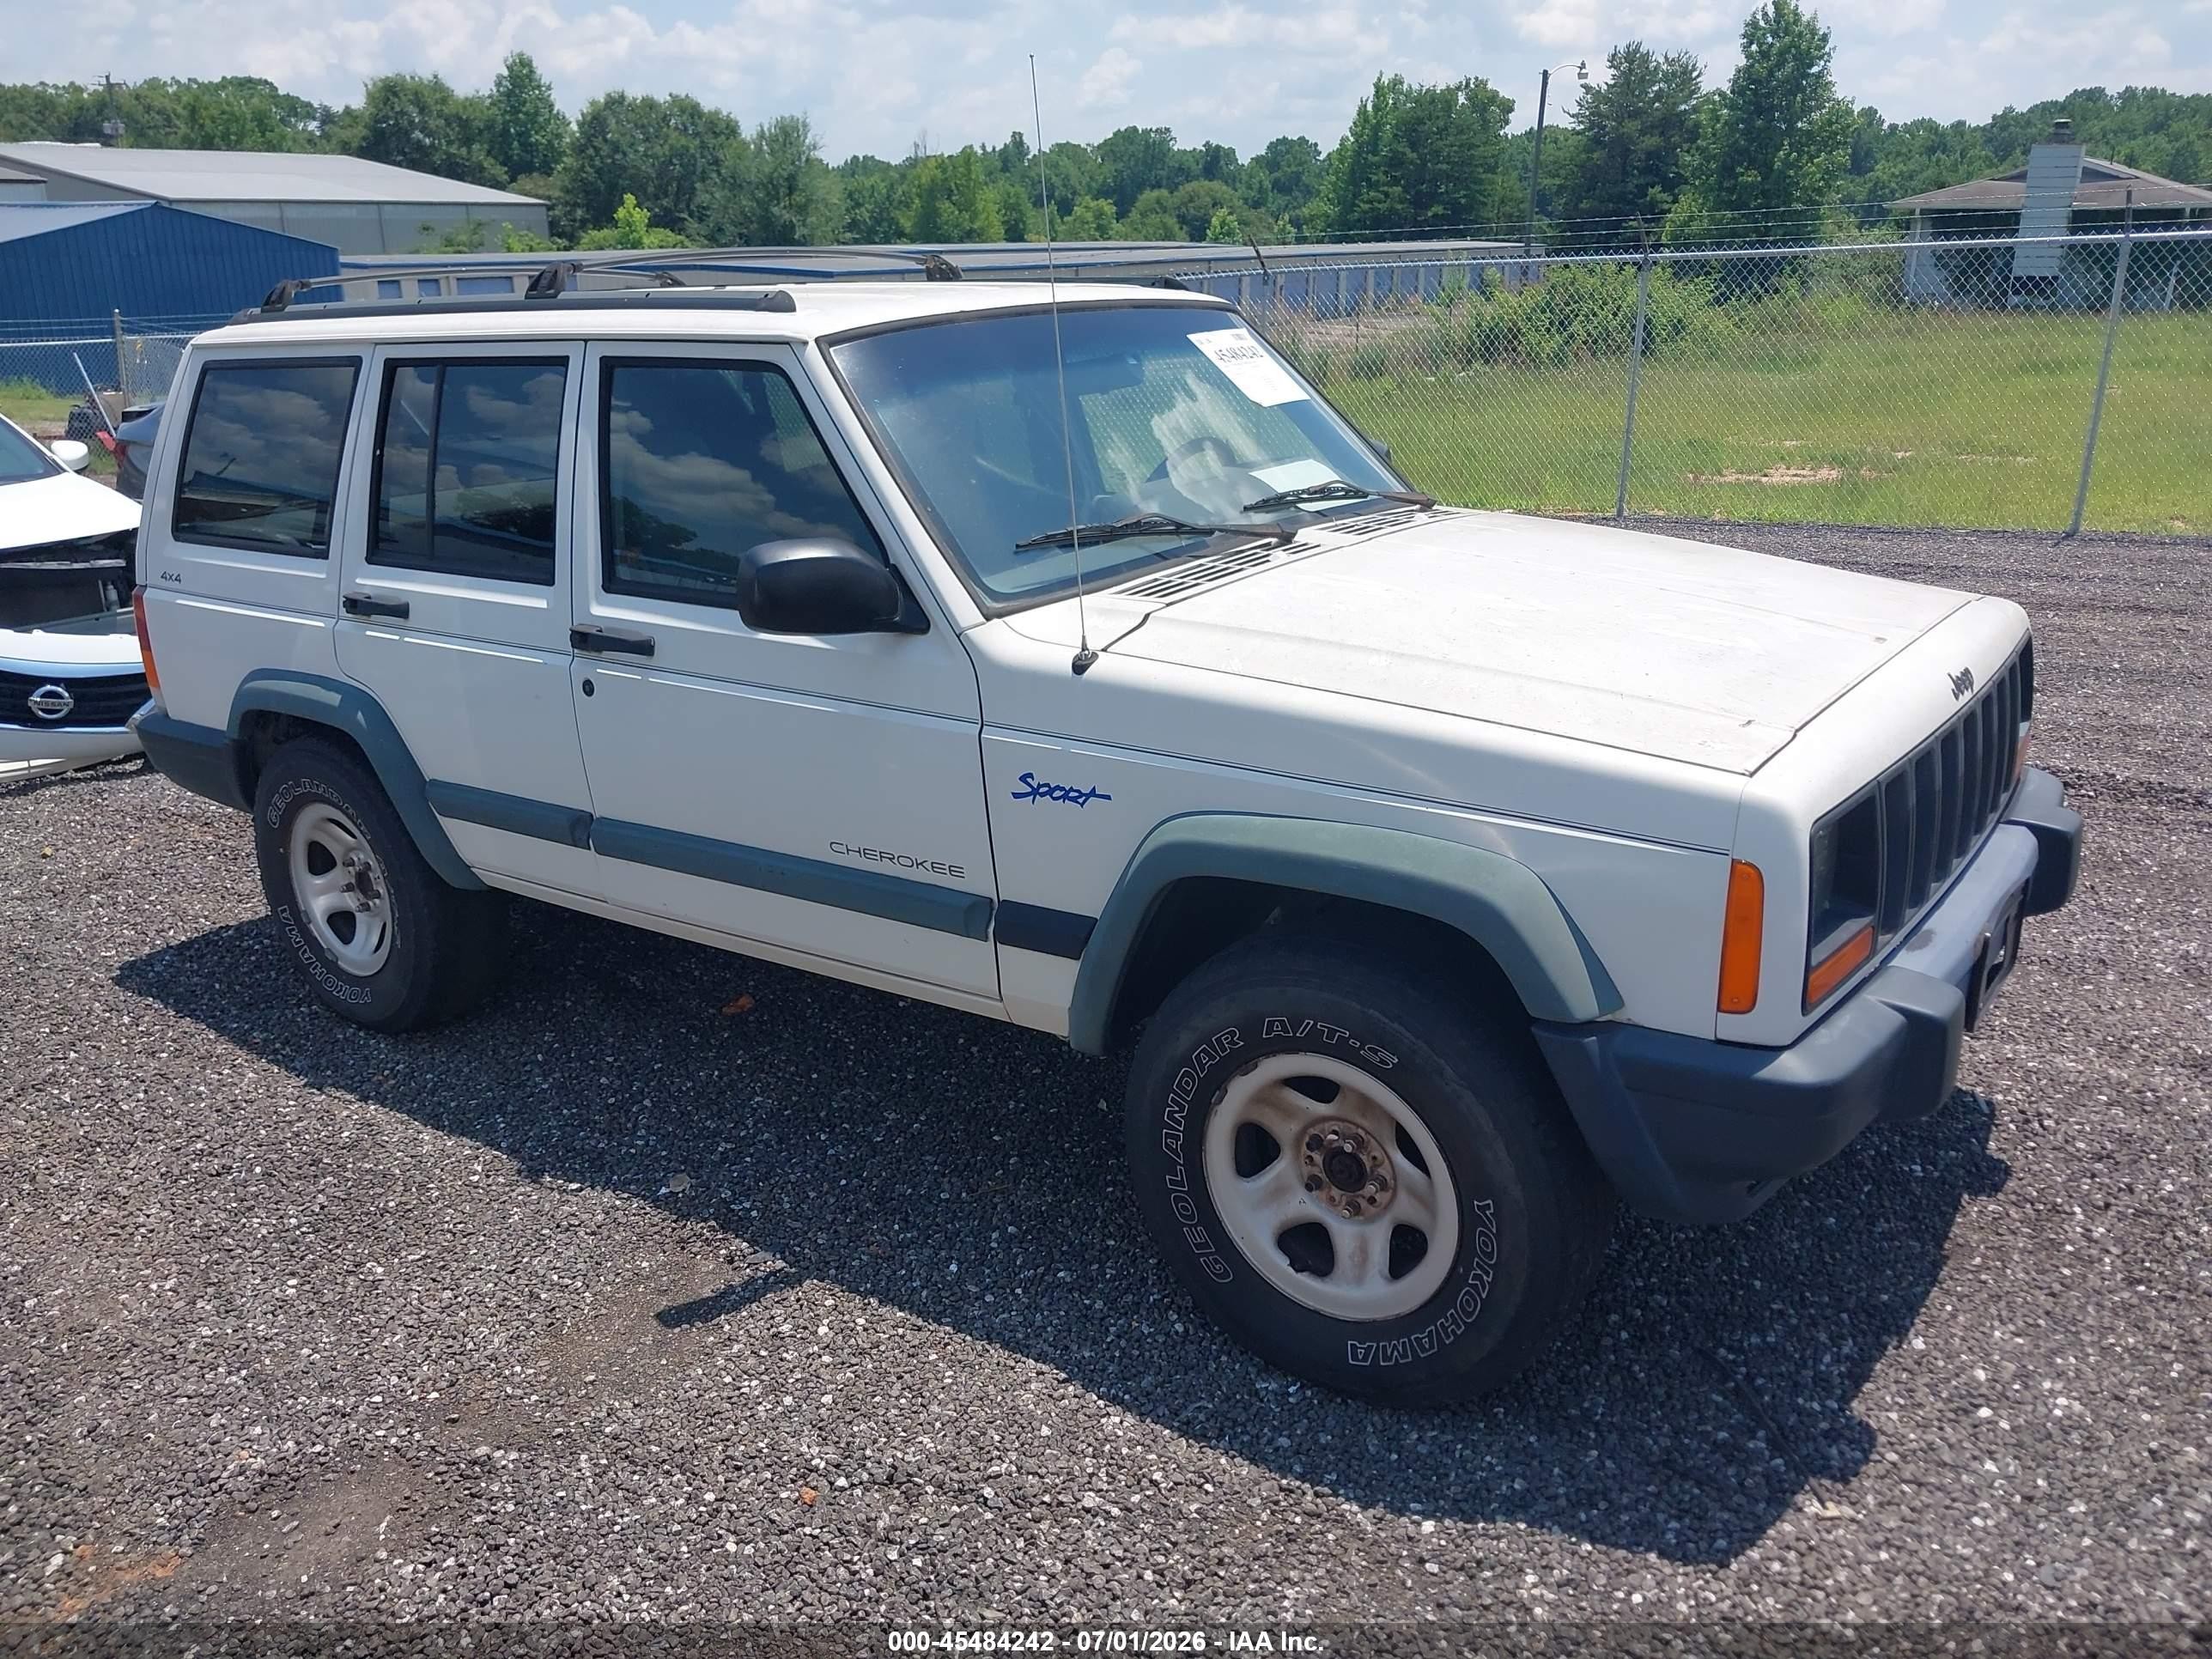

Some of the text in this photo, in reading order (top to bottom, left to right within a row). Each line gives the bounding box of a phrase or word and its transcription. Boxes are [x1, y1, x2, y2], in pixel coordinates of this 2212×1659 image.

[161, 571, 182, 584] 4x4
[34, 700, 70, 708] NISSAN
[829, 841, 966, 879] CHEROKEE
[277, 905, 372, 1004] YOKOHAMA
[1161, 1026, 1244, 1284] GEOLANDAR
[1346, 1197, 1496, 1366] YOKOHAMA
